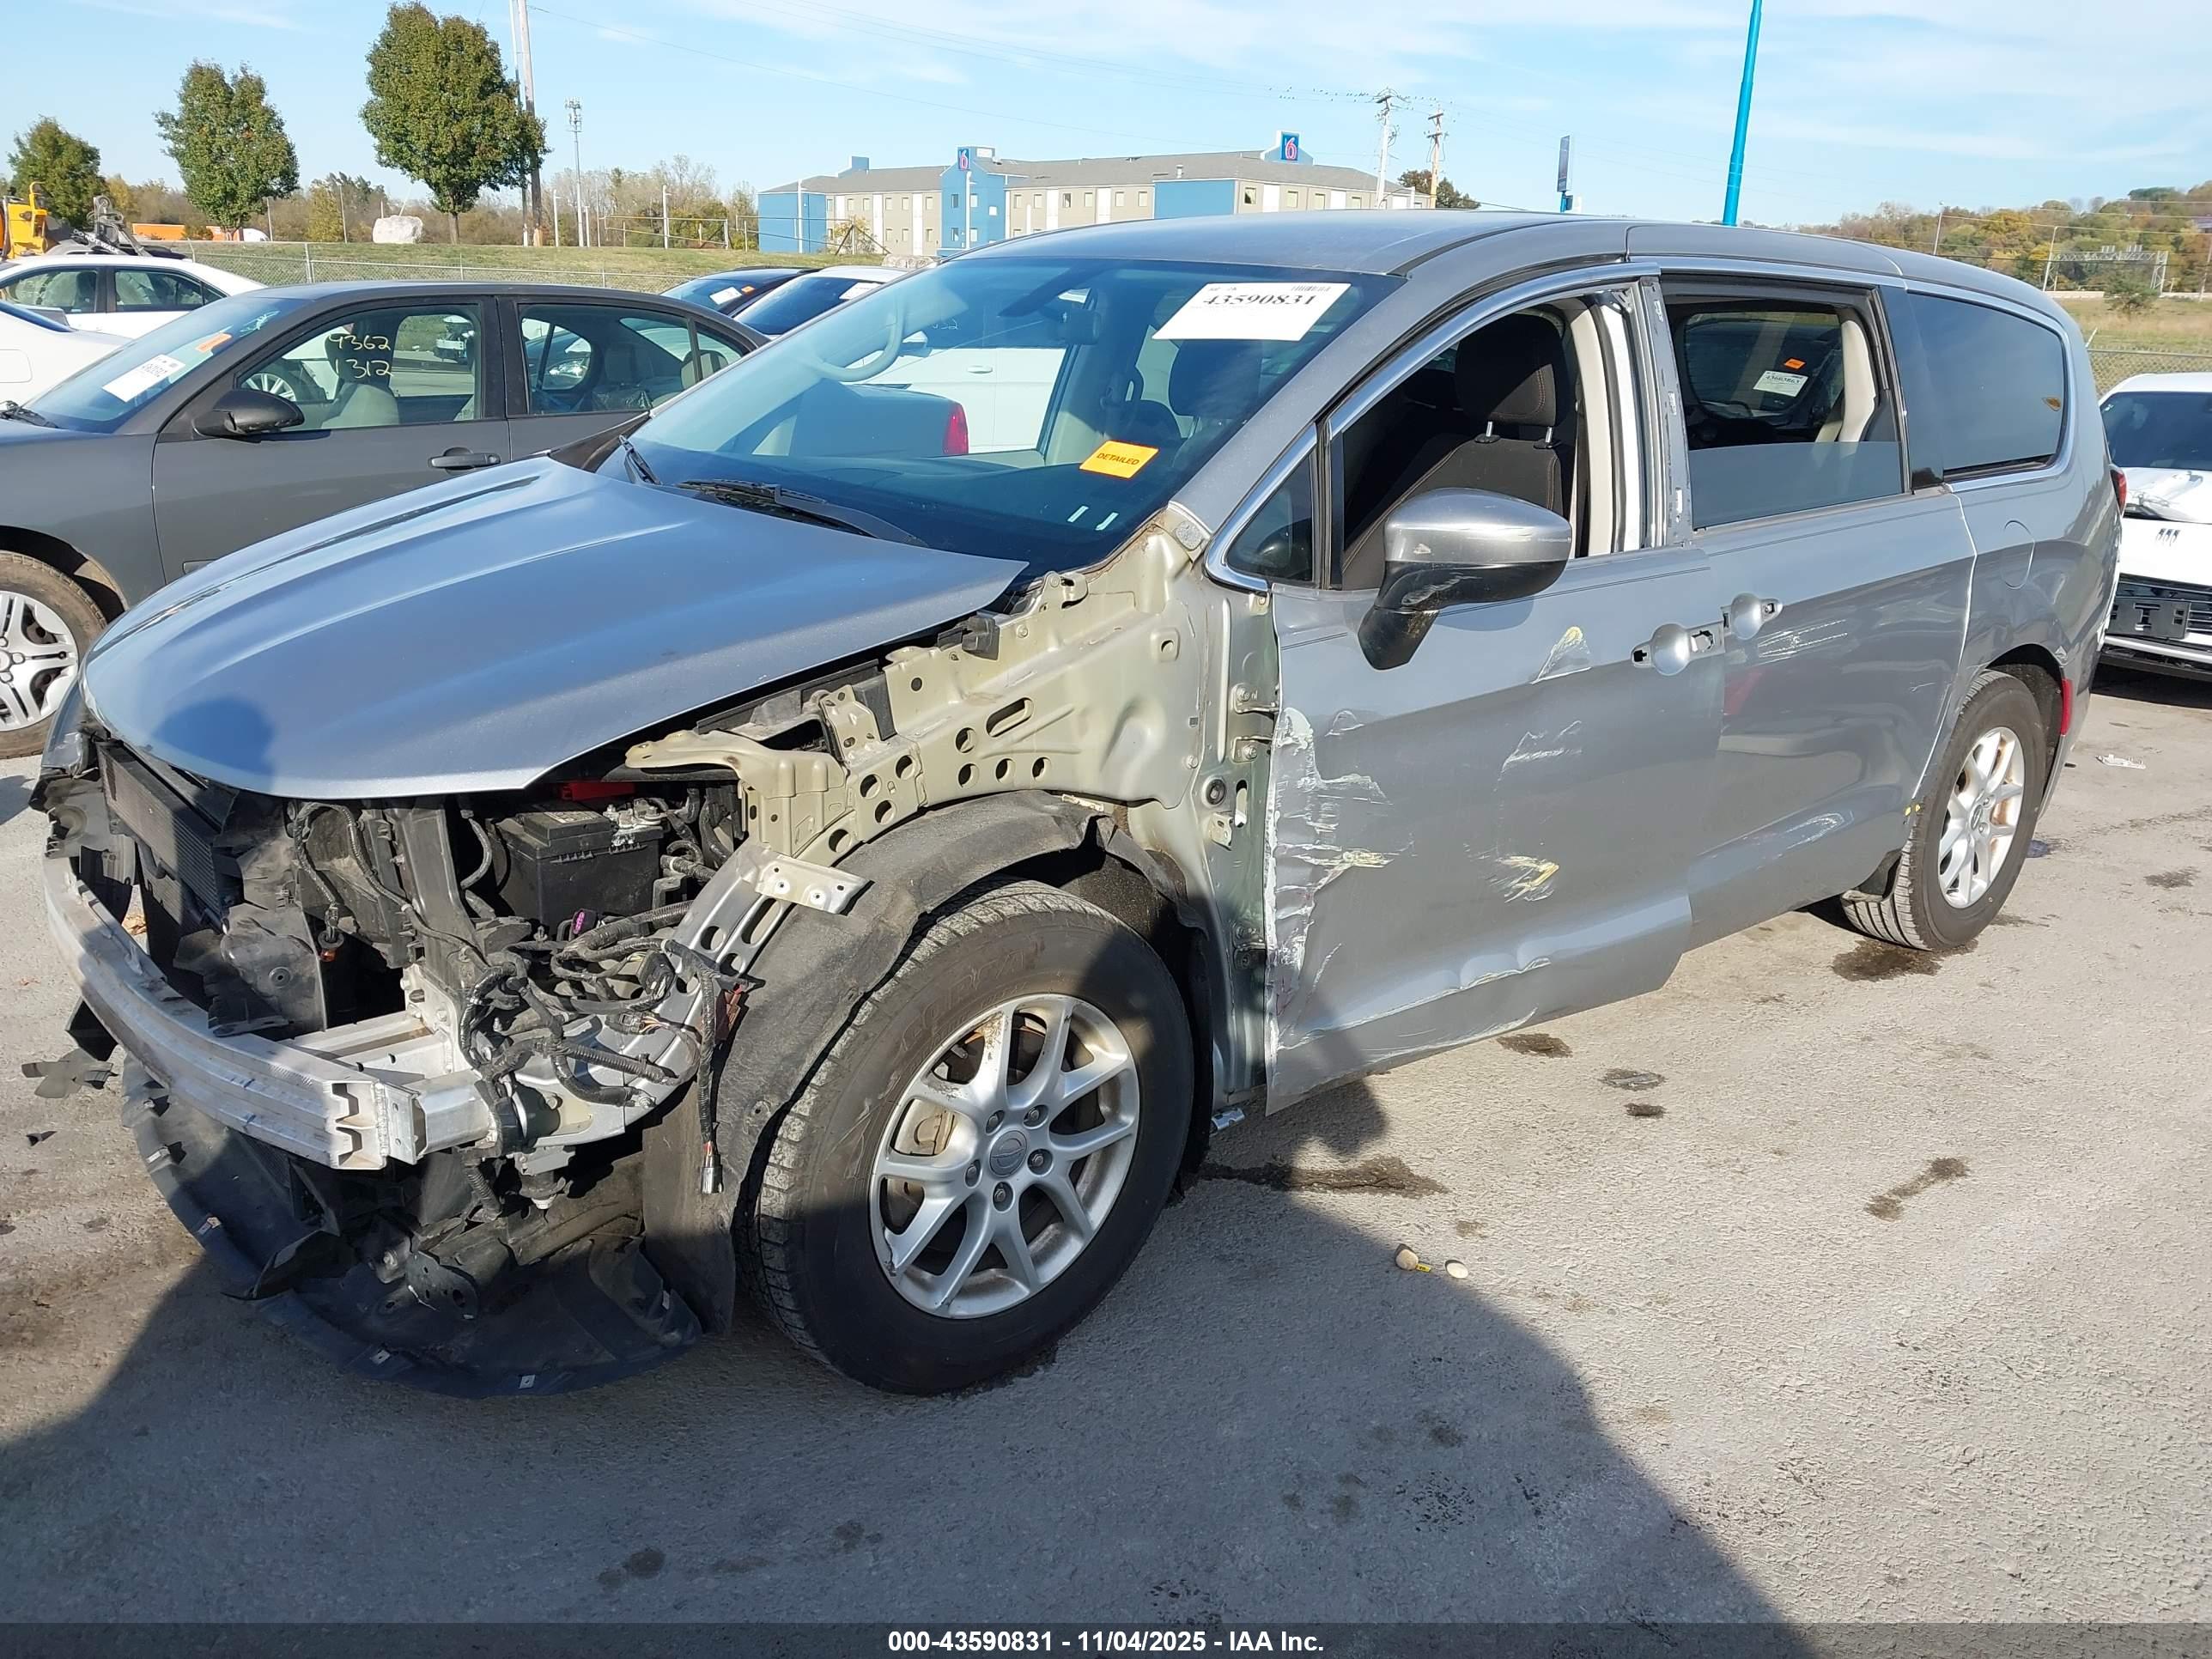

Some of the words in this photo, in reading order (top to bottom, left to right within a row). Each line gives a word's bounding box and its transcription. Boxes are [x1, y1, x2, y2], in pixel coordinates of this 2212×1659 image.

[73, 228, 84, 237] DO
[85, 233, 100, 247] NOT
[1203, 294, 1317, 305] 43590831
[335, 358, 394, 379] 1312
[1096, 453, 1140, 465] DETAILED
